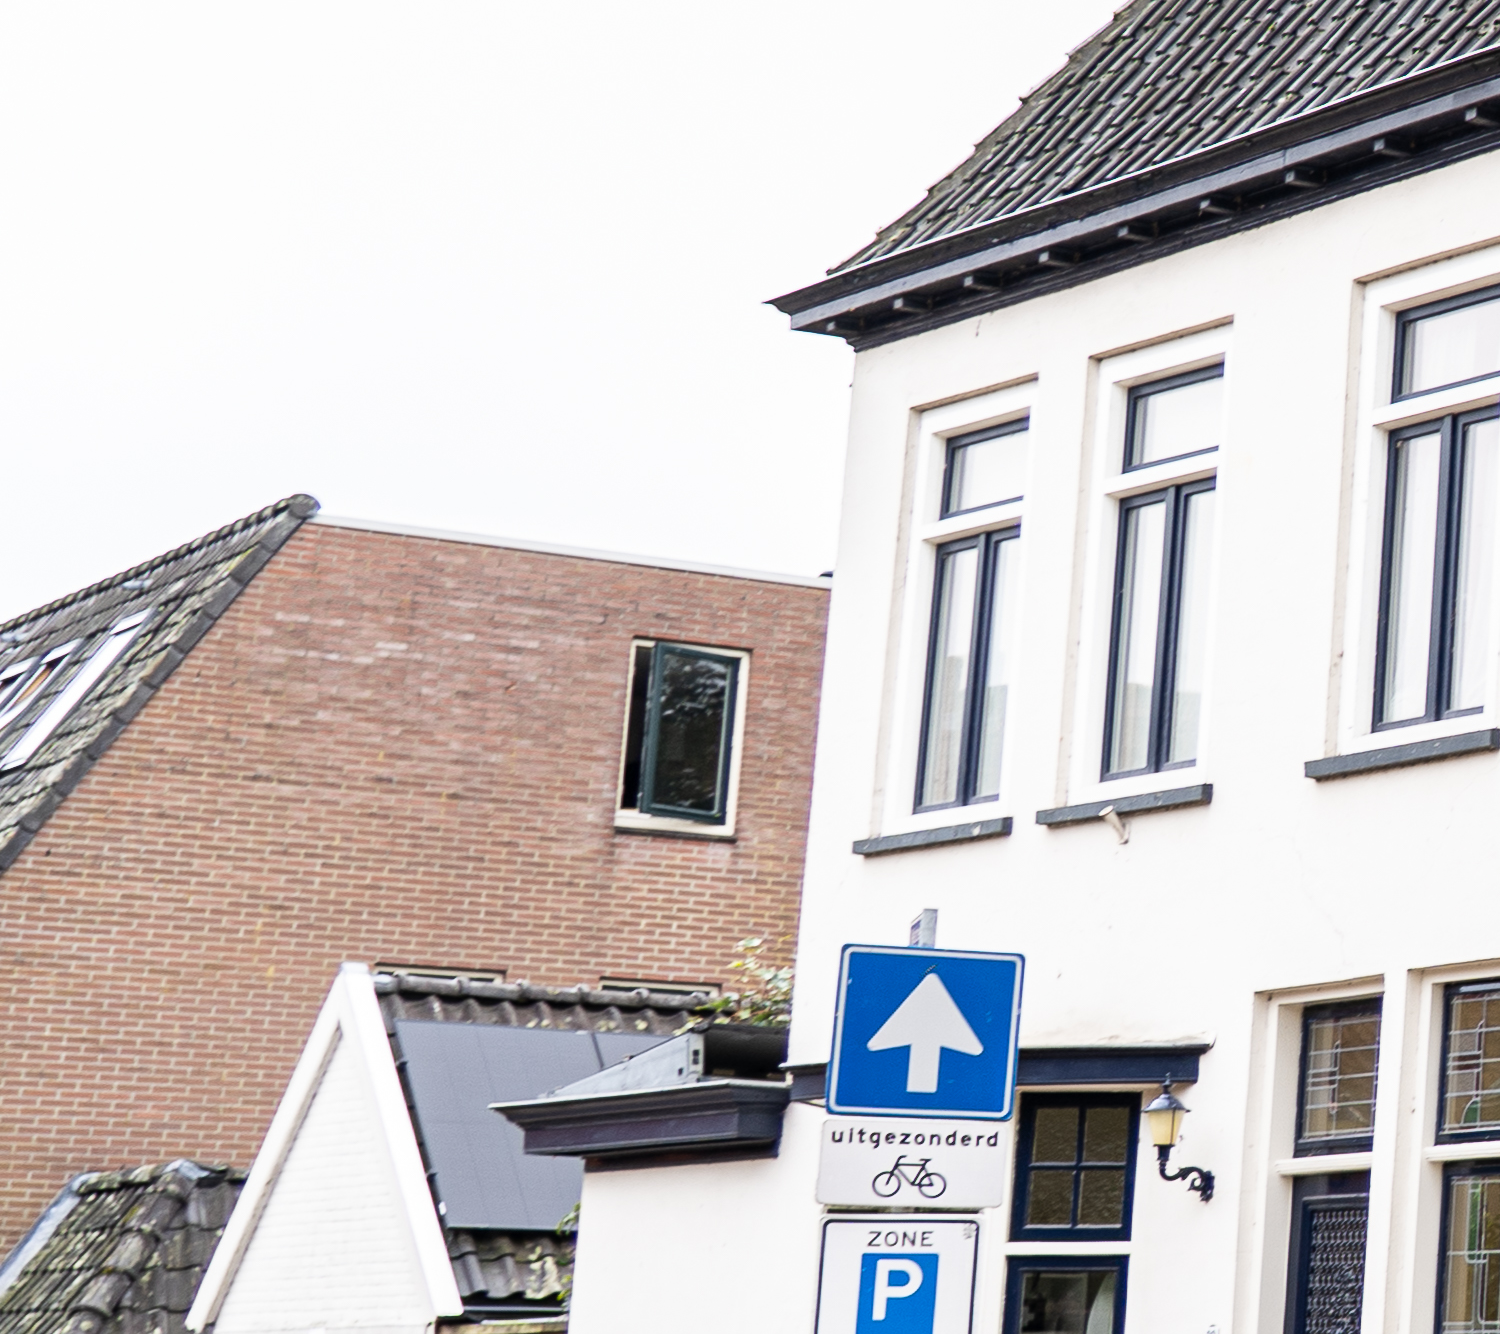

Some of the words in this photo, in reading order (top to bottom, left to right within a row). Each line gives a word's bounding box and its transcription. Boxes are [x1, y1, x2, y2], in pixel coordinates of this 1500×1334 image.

[831, 1127, 999, 1149] uitgezonderd
[867, 1230, 934, 1247] ZONE
[872, 1258, 924, 1321] P
